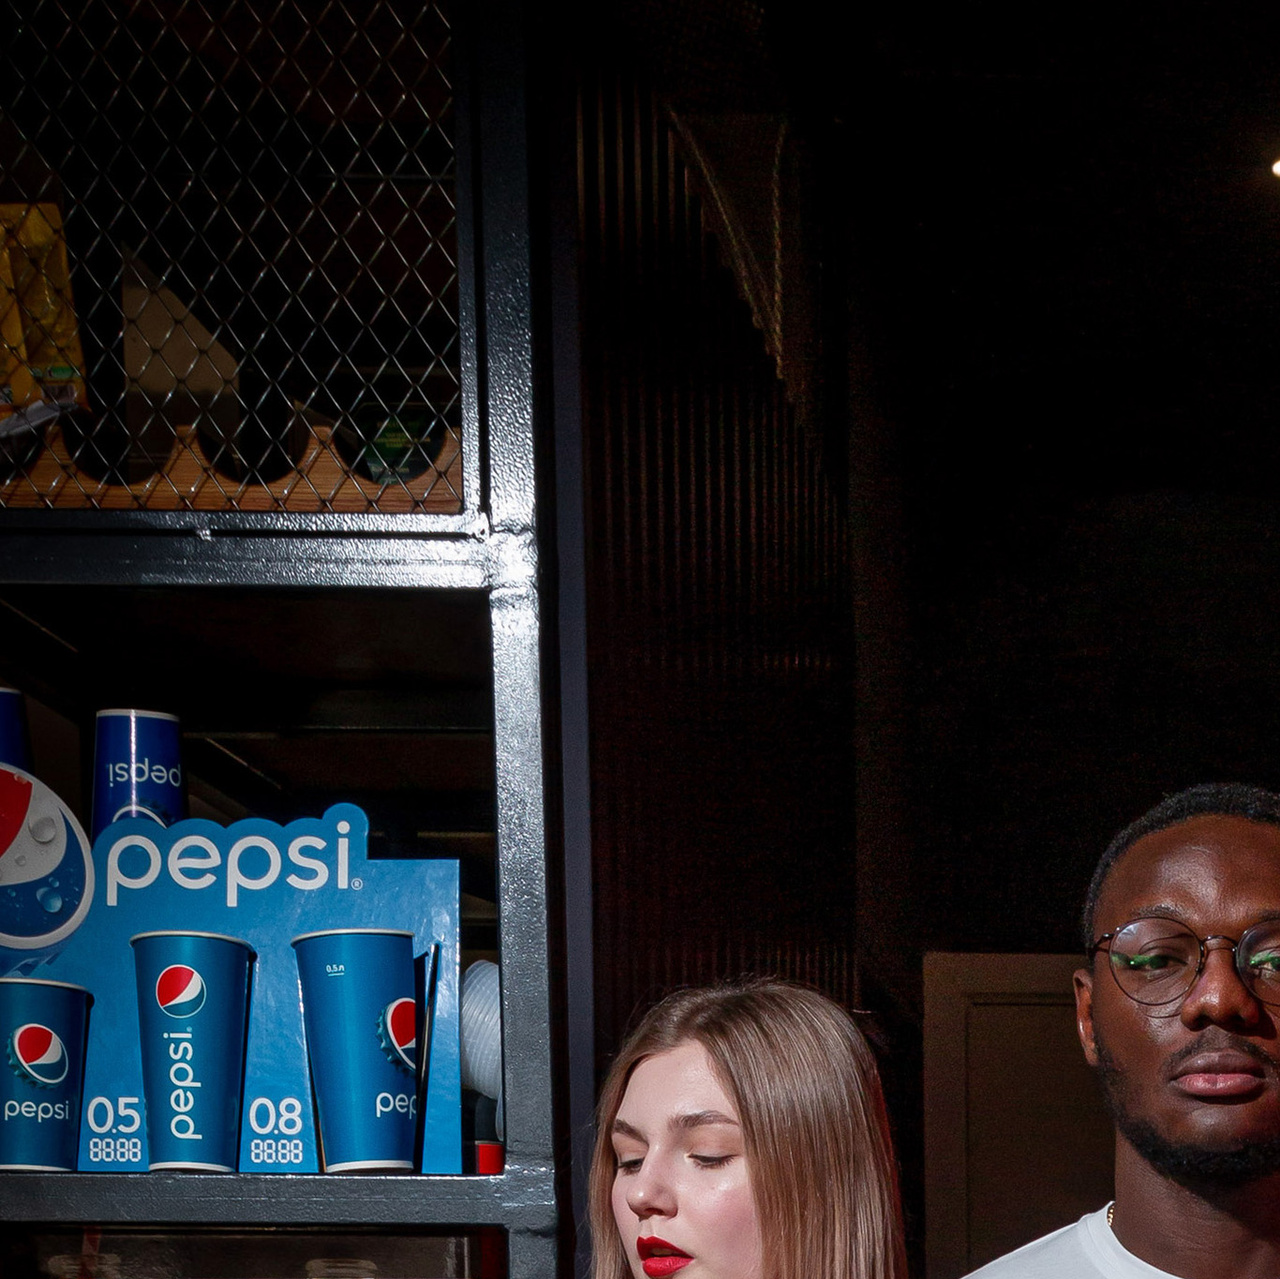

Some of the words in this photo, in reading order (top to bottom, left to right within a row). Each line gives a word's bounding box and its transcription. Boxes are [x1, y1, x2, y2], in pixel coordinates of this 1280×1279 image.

[109, 757, 182, 788] pepsi
[107, 820, 350, 907] pepsi
[163, 1032, 203, 1140] pepsi
[4, 1100, 69, 1123] pepsi
[87, 1096, 141, 1134] 0.5
[250, 1097, 303, 1135] 0.8
